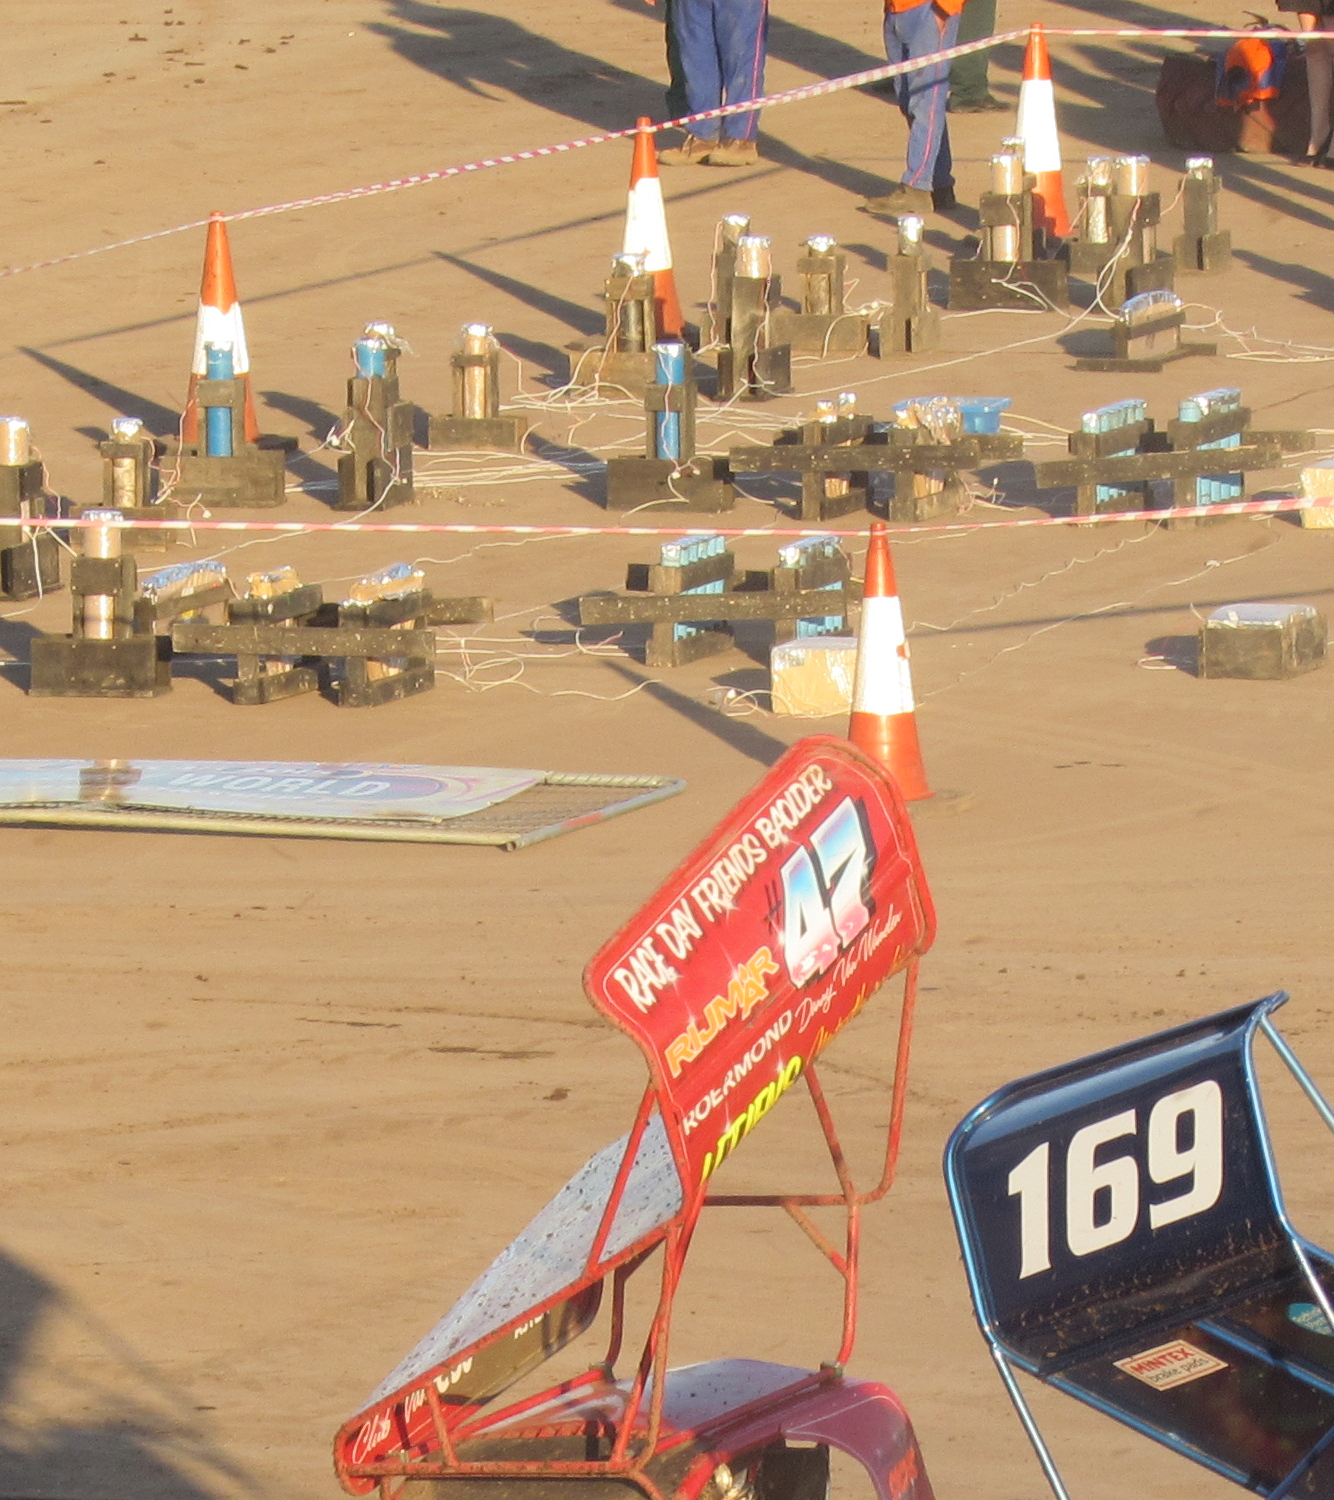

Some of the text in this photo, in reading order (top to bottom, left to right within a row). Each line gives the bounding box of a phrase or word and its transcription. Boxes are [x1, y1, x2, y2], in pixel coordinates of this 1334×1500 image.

[168, 773, 391, 797] WORLD
[613, 936, 673, 1014] RACE
[655, 898, 703, 960] DAY
[691, 832, 768, 923] FRIENDS
[682, 1008, 793, 1136] ROERMOND
[1008, 1079, 1224, 1280] 169
[1129, 1347, 1195, 1376] MINTEX
[1179, 1357, 1210, 1374] pads
